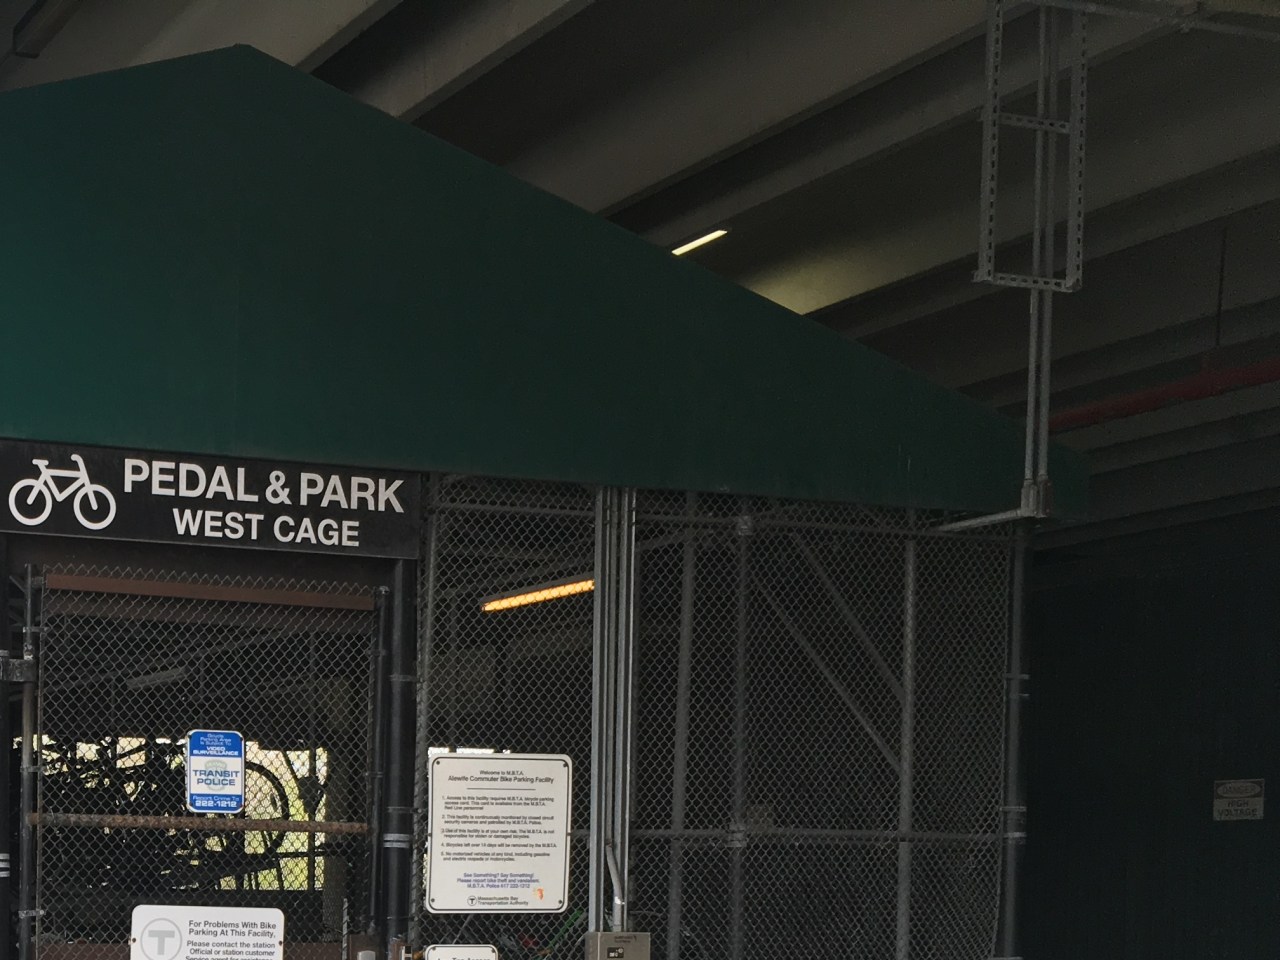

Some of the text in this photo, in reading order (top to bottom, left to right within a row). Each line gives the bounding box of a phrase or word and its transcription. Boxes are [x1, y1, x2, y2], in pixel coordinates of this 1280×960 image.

[123, 458, 404, 513] PEDAL & PARK
[172, 508, 359, 547] WEST CAGE
[197, 778, 235, 786] POLICE
[189, 928, 217, 937] Parking
[203, 920, 239, 928] Problems
[241, 921, 258, 929] With
[148, 930, 175, 955] T
